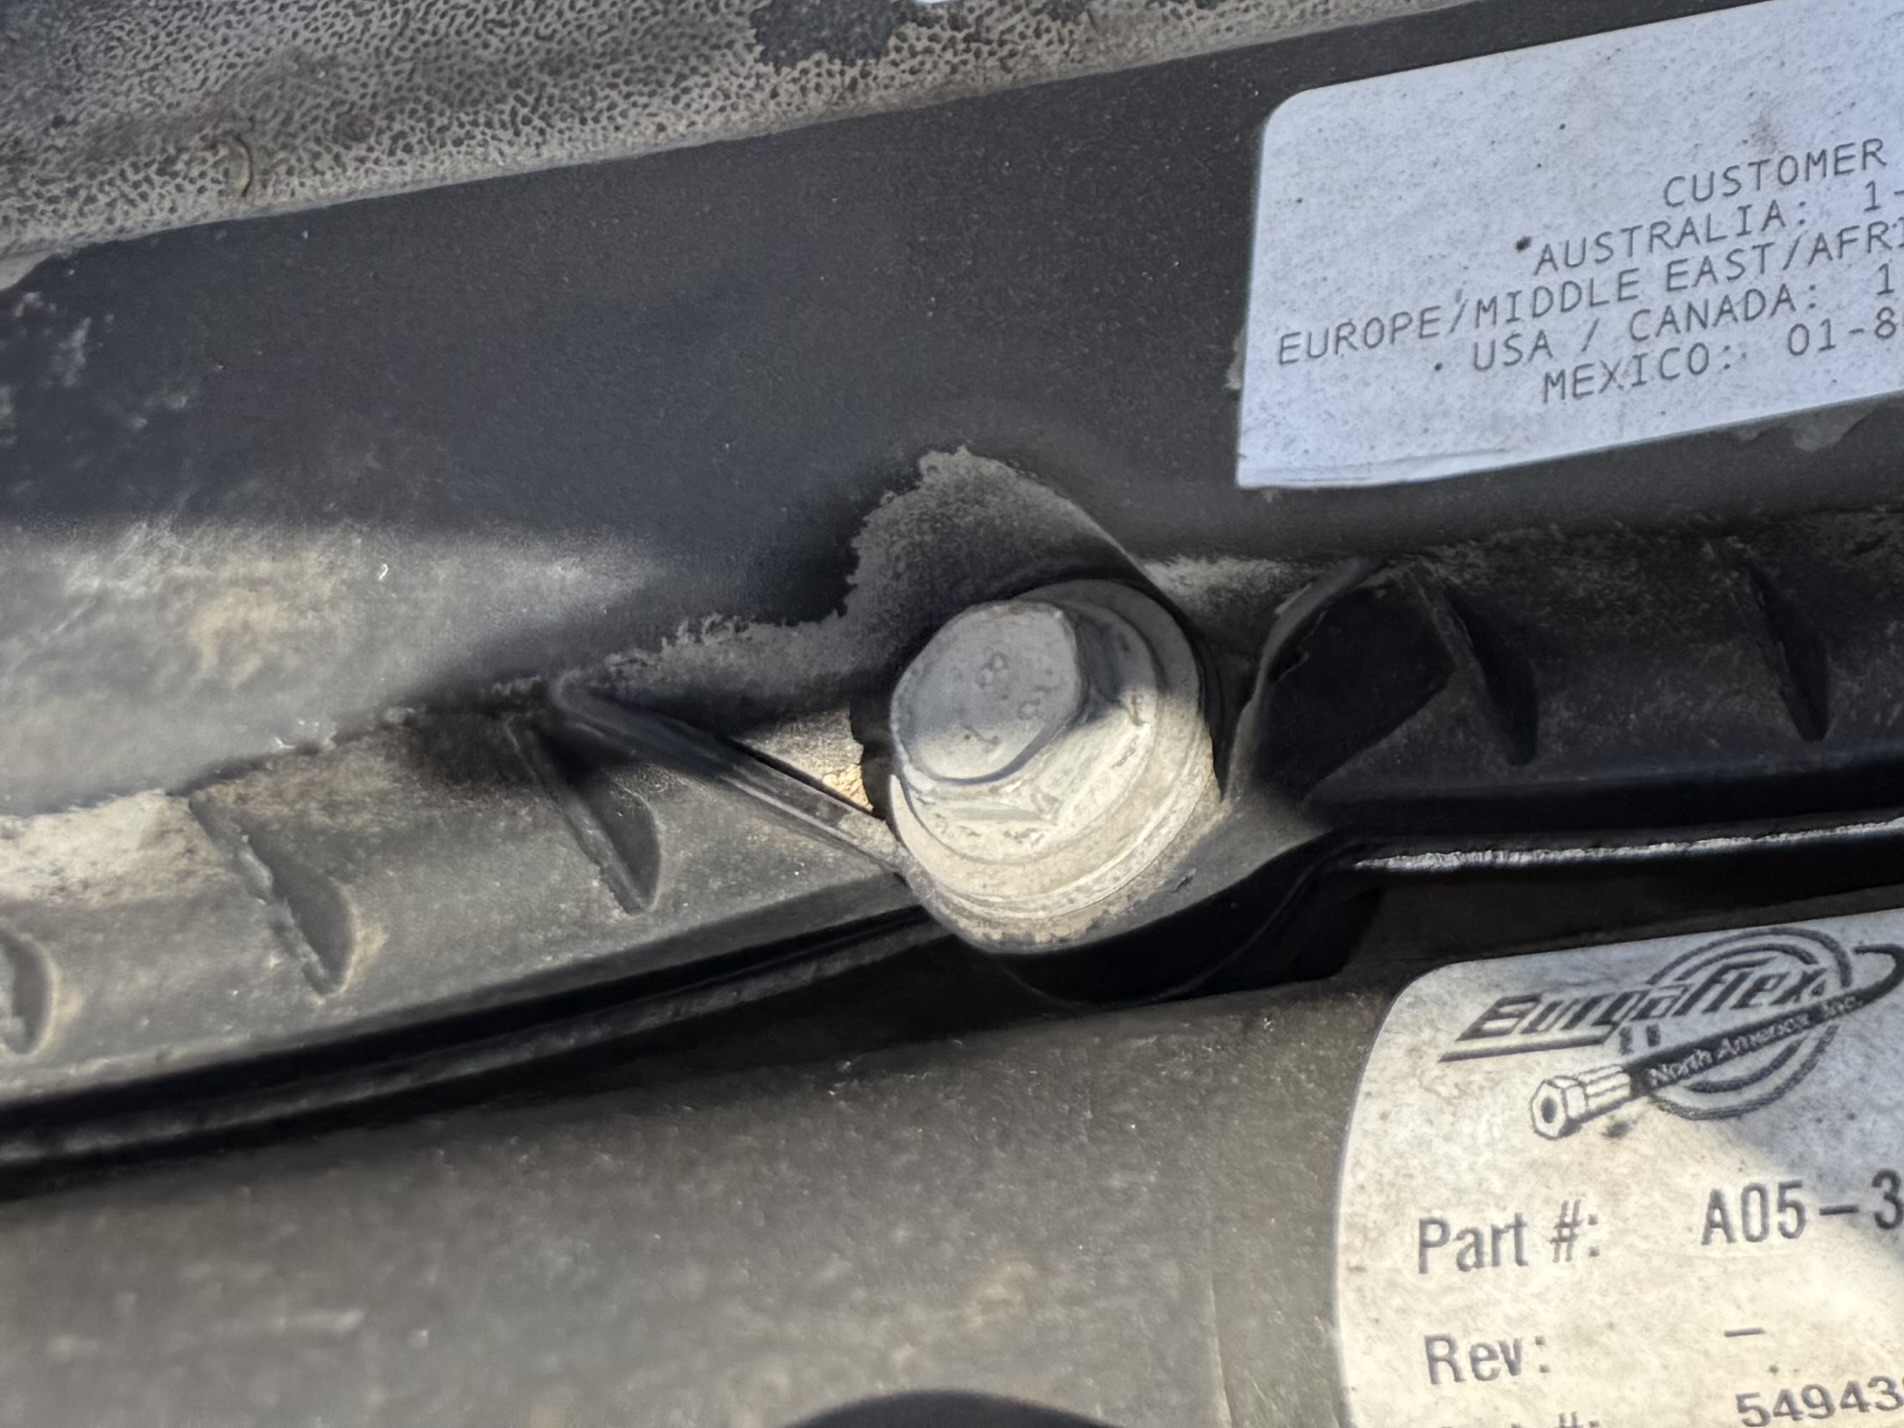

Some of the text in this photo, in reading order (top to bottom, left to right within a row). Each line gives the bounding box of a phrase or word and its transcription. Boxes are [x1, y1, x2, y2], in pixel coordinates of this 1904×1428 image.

[1662, 135, 1889, 212] CUSTOMER
[1532, 191, 1809, 282] AUSTRALIA:
[1274, 264, 1643, 372] EUROPE/MIDDLE
[1470, 325, 1562, 379] USA
[1626, 276, 1818, 351] CANADA:
[1541, 330, 1740, 409] MEXICO:
[1415, 1210, 1534, 1274] Part
[1550, 1203, 1602, 1265] #:
[1425, 1331, 1550, 1386] Rev:
